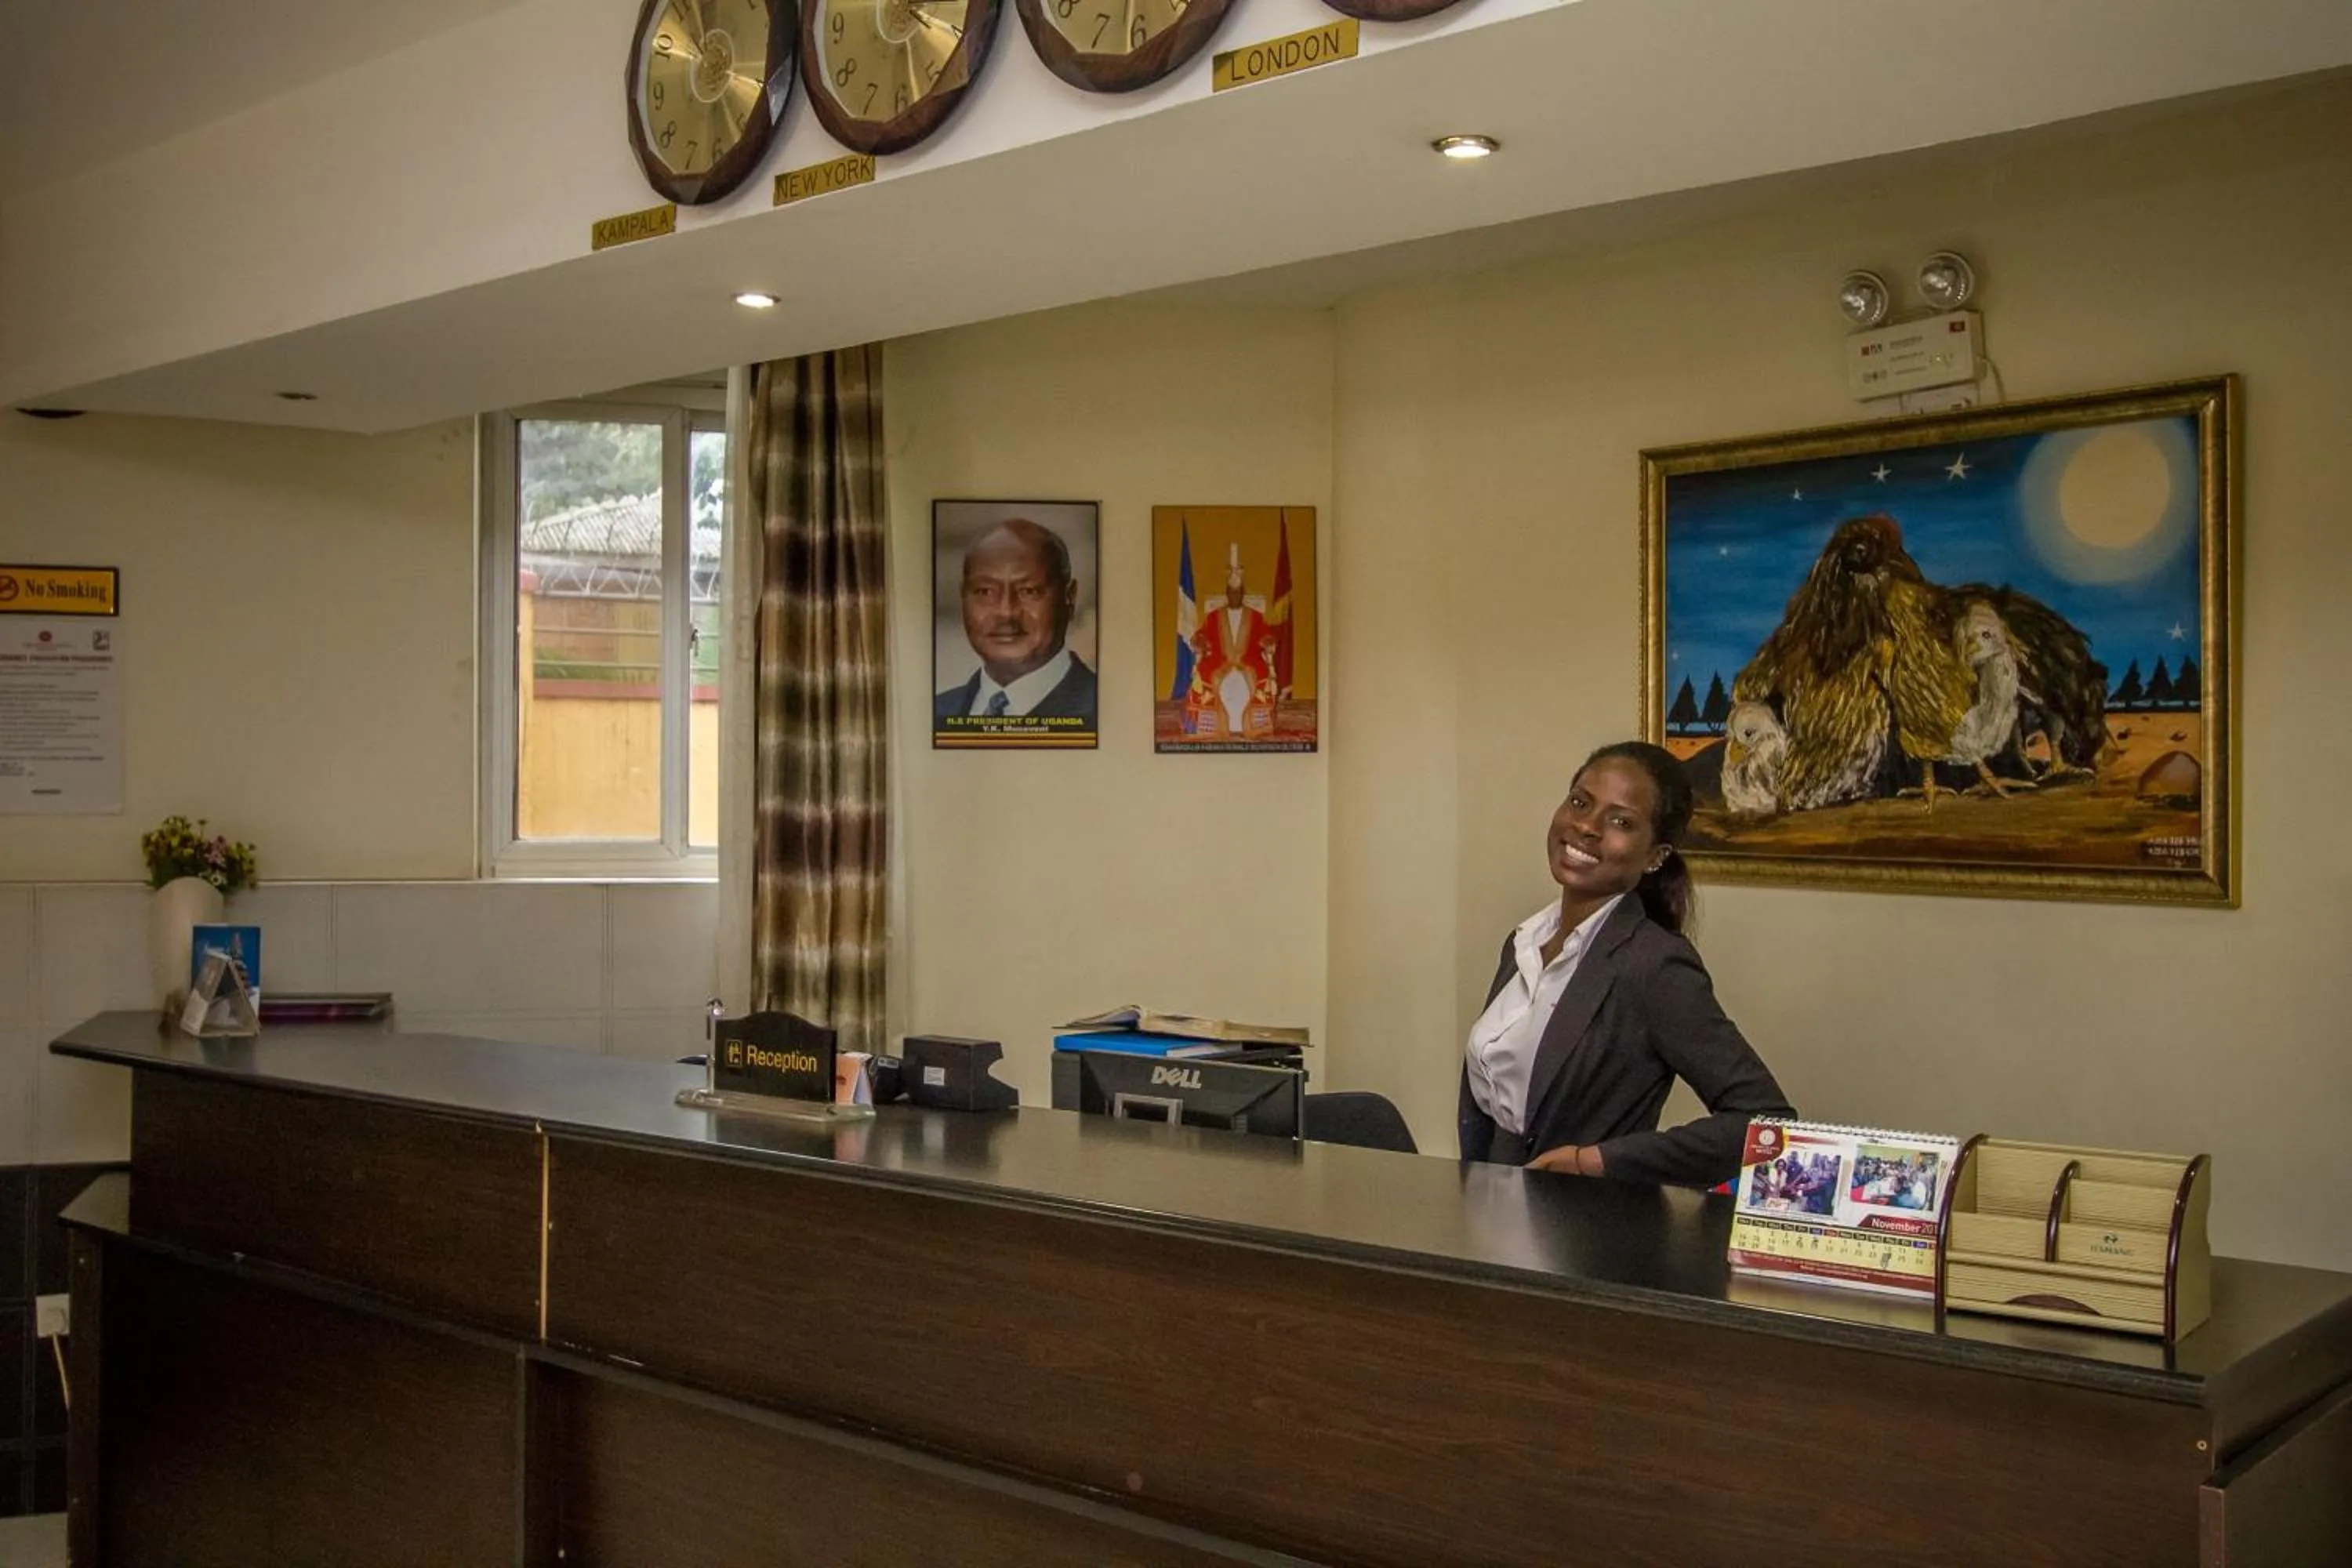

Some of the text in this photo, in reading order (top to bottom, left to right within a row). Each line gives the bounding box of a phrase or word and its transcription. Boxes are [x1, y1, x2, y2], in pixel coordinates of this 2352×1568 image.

[832, 12, 844, 45] 9
[1091, 13, 1110, 49] 7
[1229, 28, 1341, 82] LONDON
[836, 57, 857, 88] 8
[653, 81, 664, 111] 9
[863, 82, 878, 115] 7
[660, 120, 677, 149] 8
[685, 140, 699, 170] 7
[775, 159, 873, 201] NEW YORK
[597, 209, 669, 241] KAMPALA
[25, 579, 106, 603] No Smoking
[746, 1044, 818, 1073] Reception
[1151, 1065, 1202, 1089] DELL
[1871, 1218, 1937, 1236] November 201
